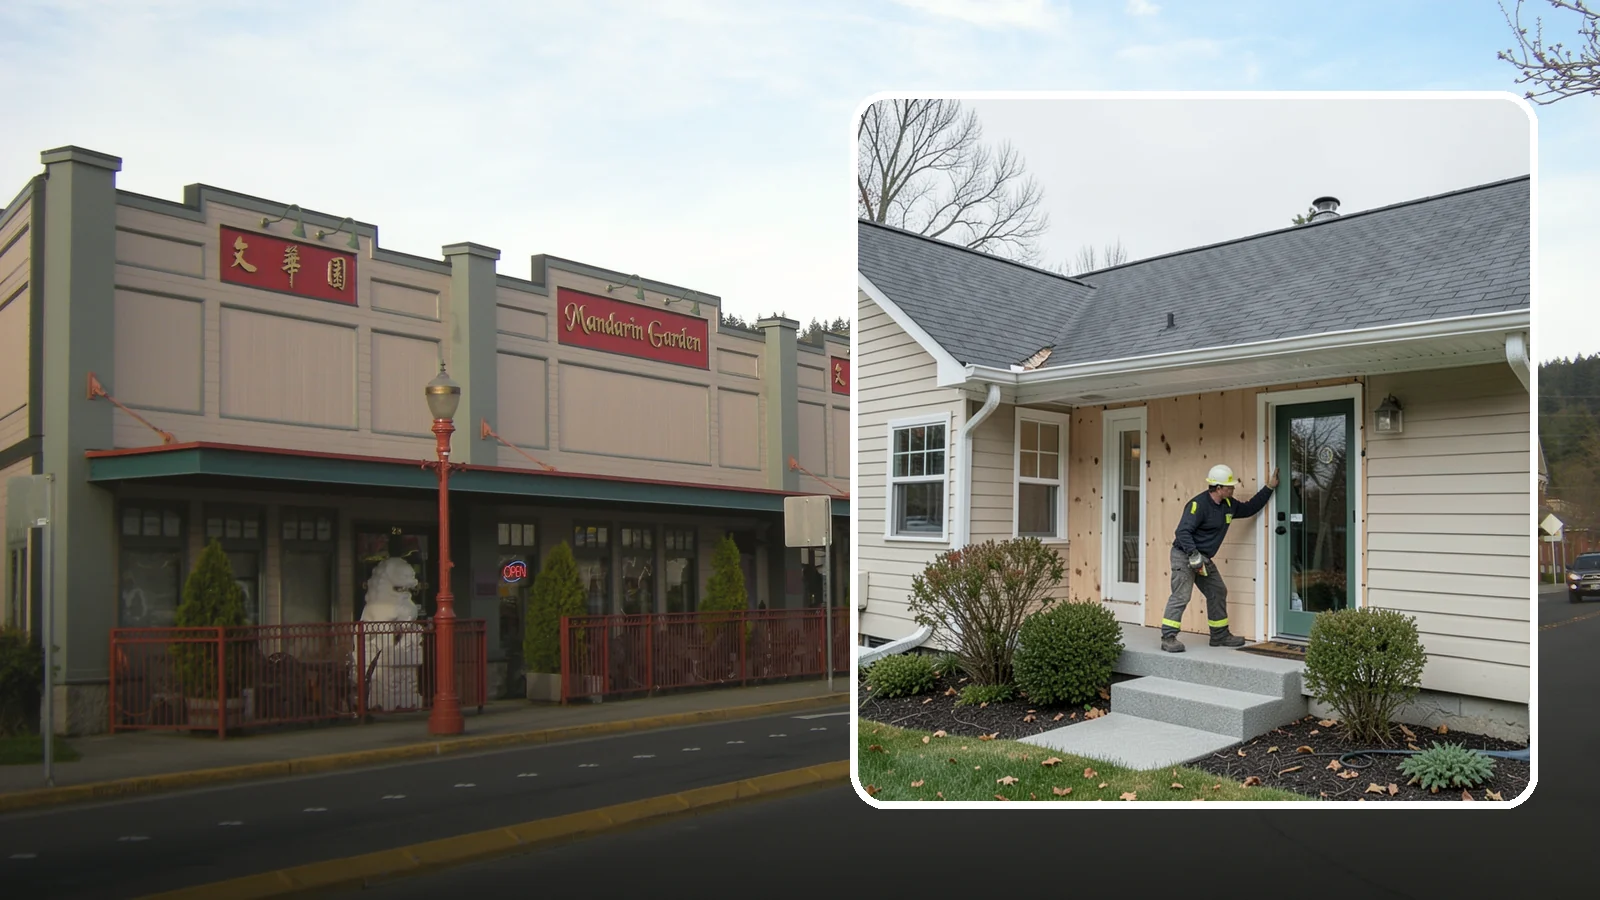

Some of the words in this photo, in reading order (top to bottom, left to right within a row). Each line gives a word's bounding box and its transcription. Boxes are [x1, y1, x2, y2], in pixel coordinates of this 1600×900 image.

[230, 235, 346, 291] 文華園
[564, 302, 644, 341] Mandarin
[648, 320, 701, 352] Garden
[835, 363, 846, 386] 文
[503, 565, 527, 578] OPEN
